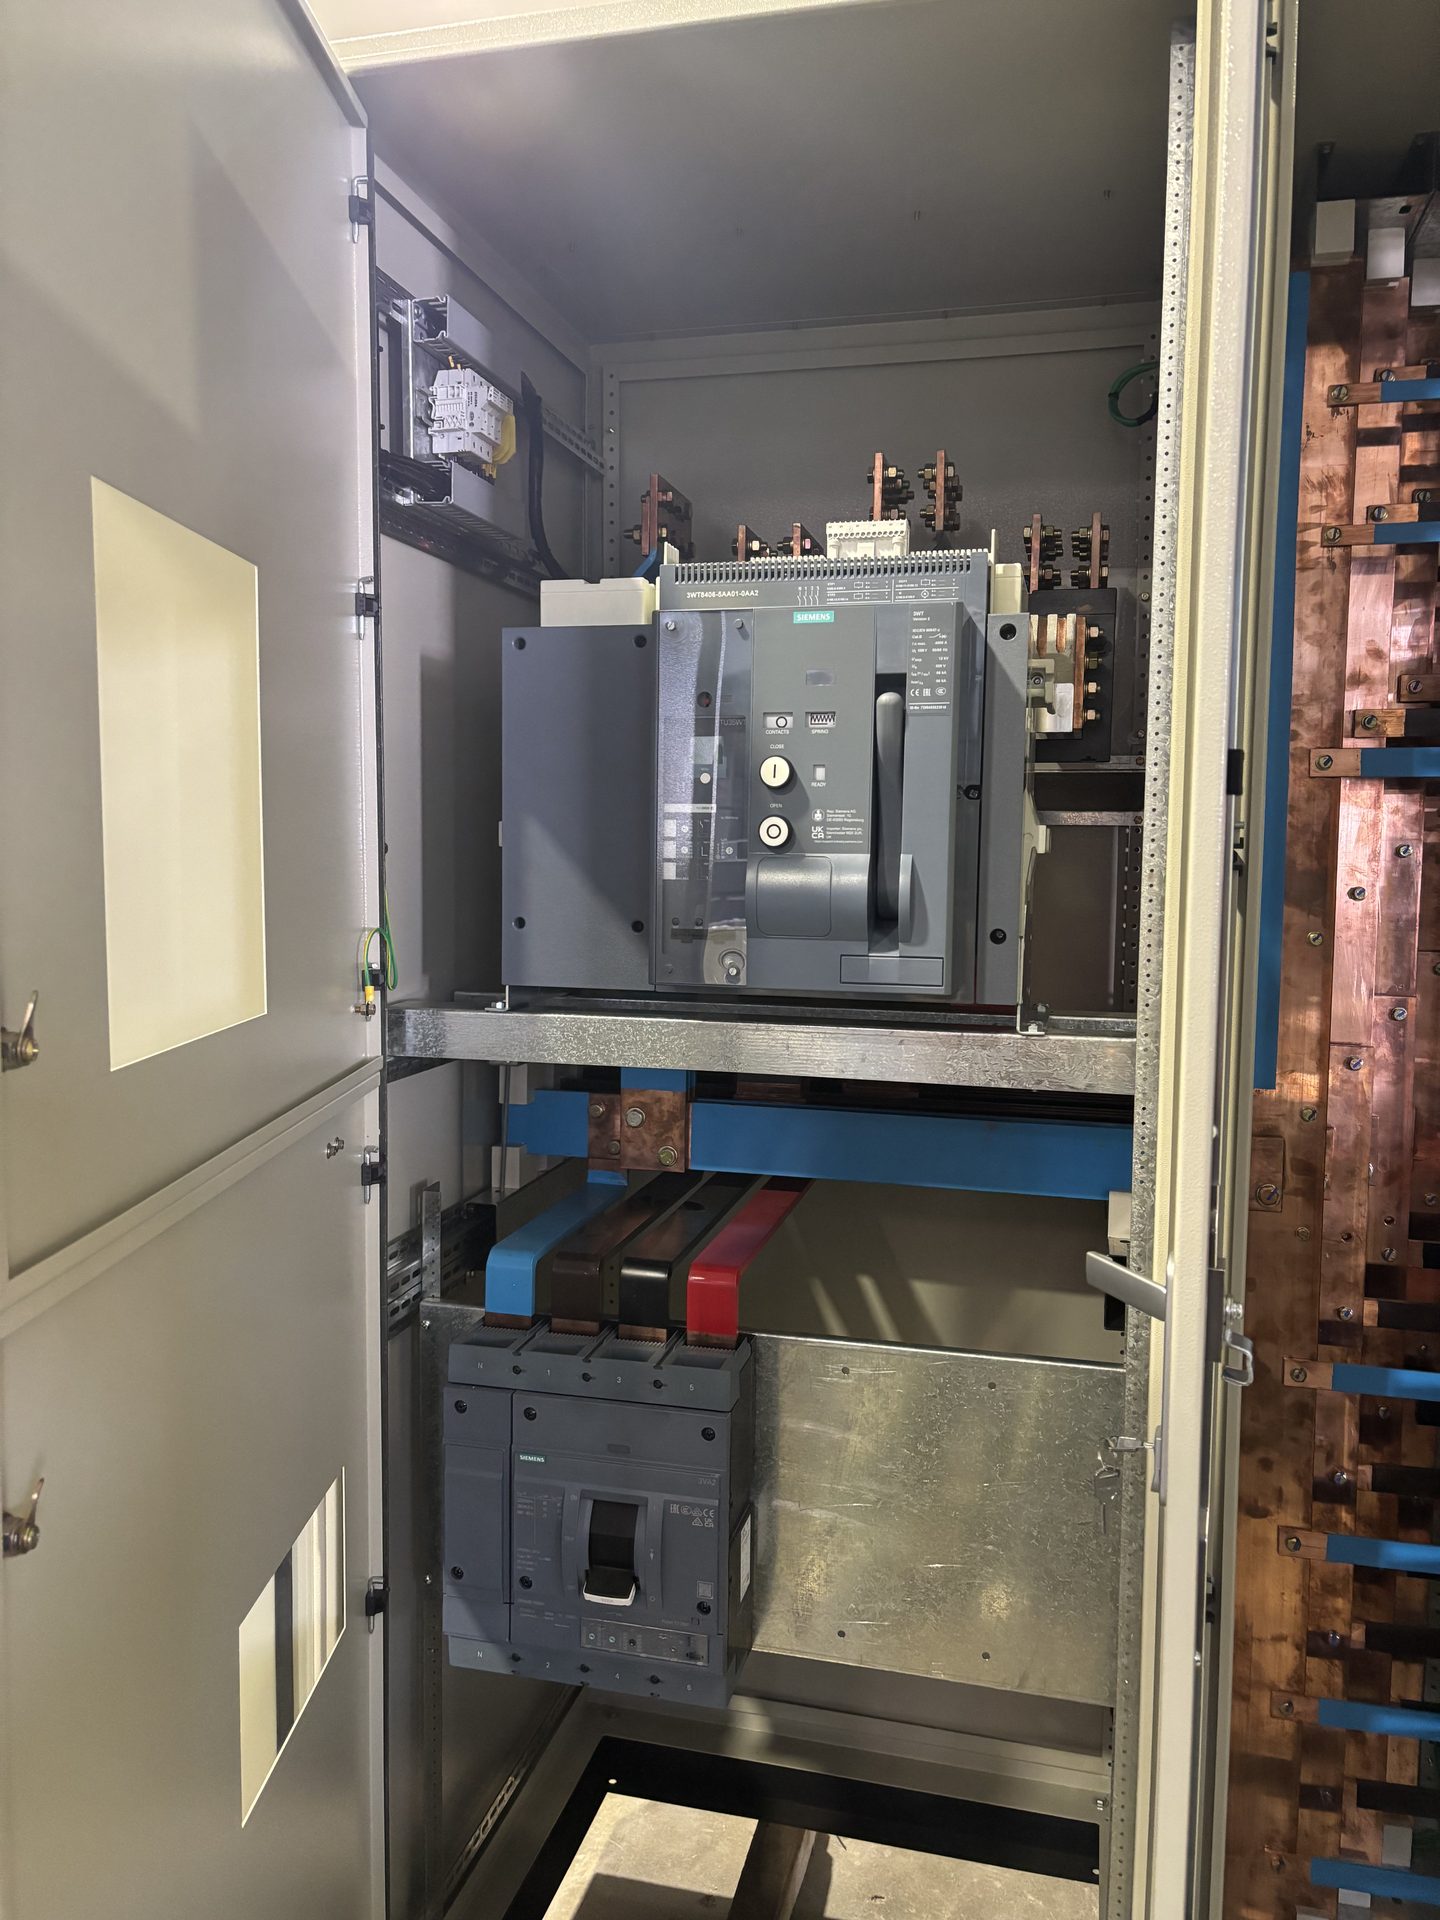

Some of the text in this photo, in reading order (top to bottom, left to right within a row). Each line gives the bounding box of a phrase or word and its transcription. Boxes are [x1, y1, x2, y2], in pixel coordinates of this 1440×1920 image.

[796, 612, 831, 622] SIEMENS
[616, 1376, 622, 1384] 3
[689, 1383, 695, 1391] 5
[519, 1454, 545, 1463] SIEMENS
[477, 1650, 484, 1658] N
[615, 1672, 621, 1680] 4
